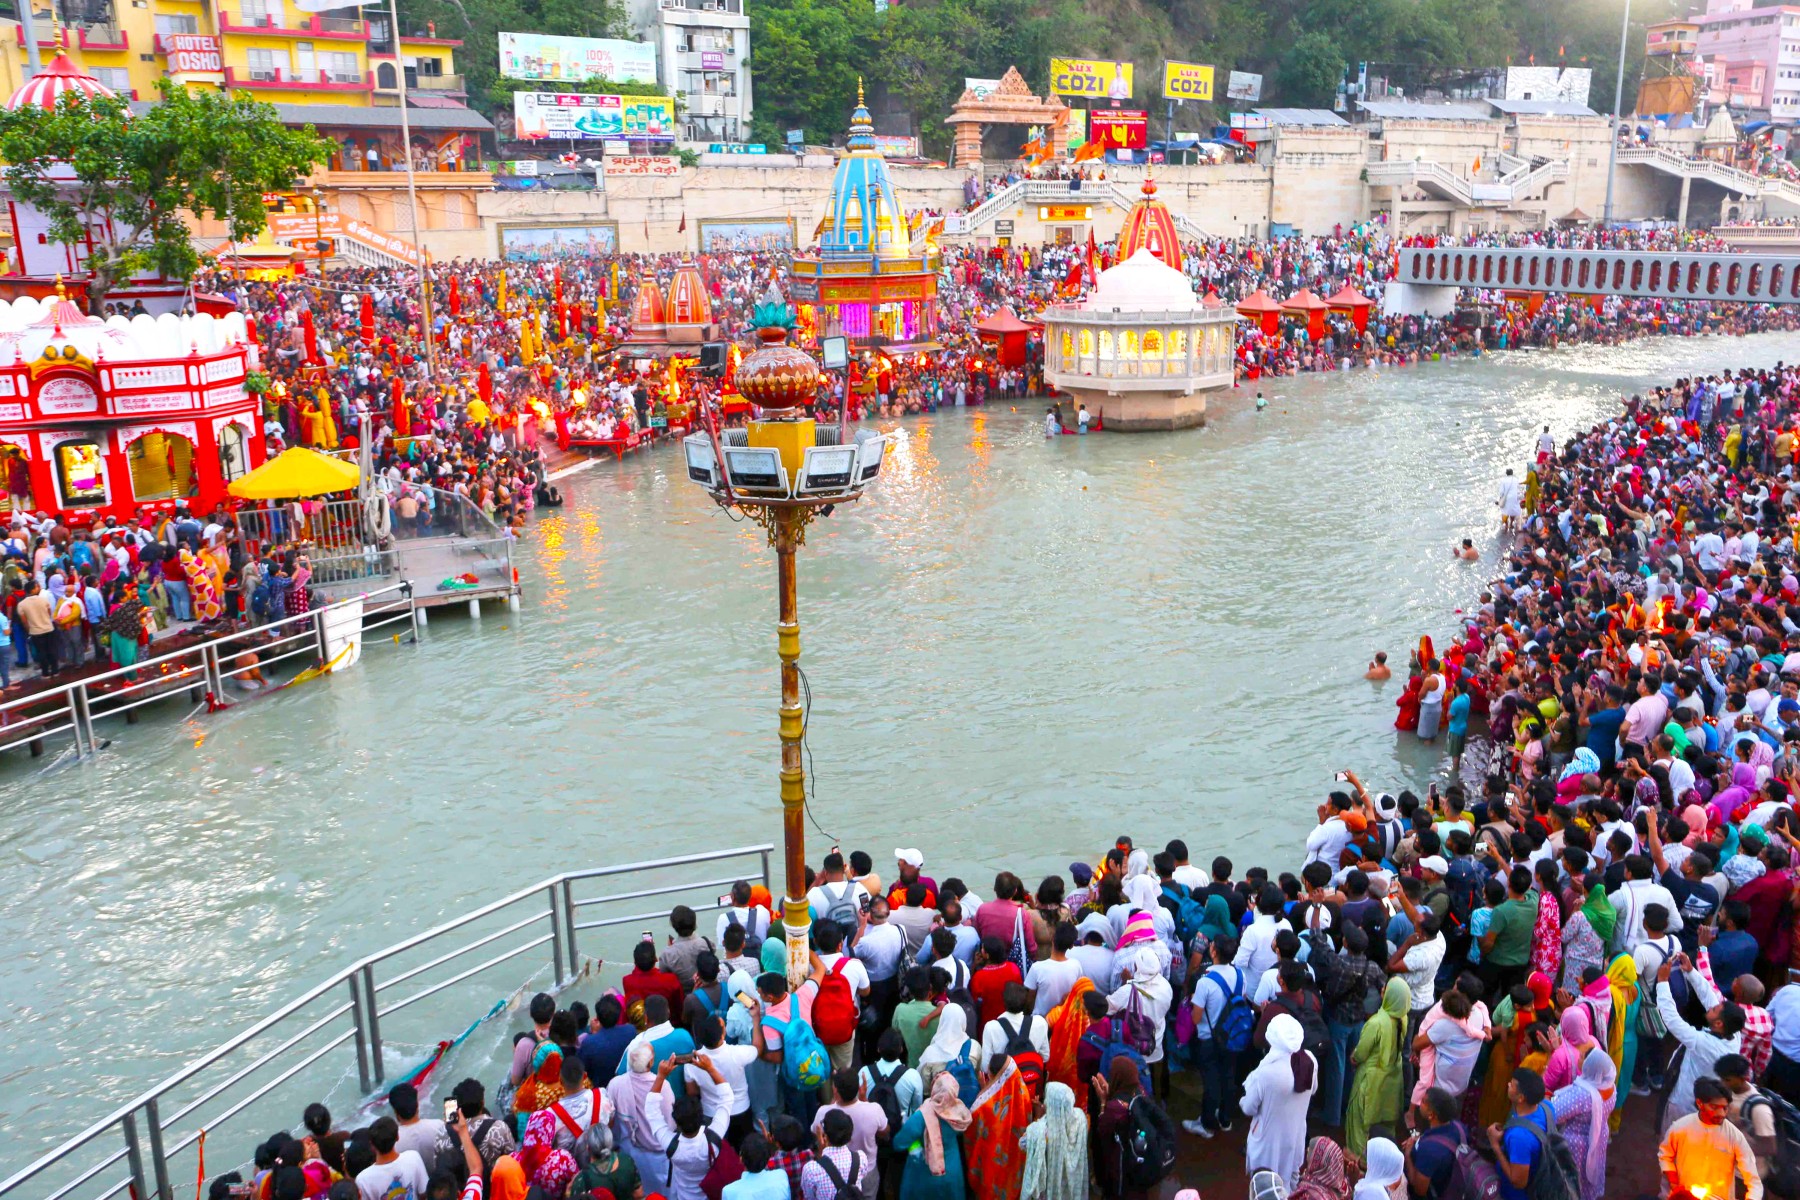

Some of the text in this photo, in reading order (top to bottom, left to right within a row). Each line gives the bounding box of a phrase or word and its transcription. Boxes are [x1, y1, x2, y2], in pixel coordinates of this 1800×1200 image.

[175, 35, 218, 50] HOTEL
[179, 51, 221, 70] OSHO
[586, 49, 612, 61] 100%
[703, 53, 722, 61] HOTEL
[1068, 63, 1092, 73] LUX
[1180, 69, 1199, 77] LUX
[1057, 74, 1103, 91] COZI
[1170, 78, 1208, 94] COZI
